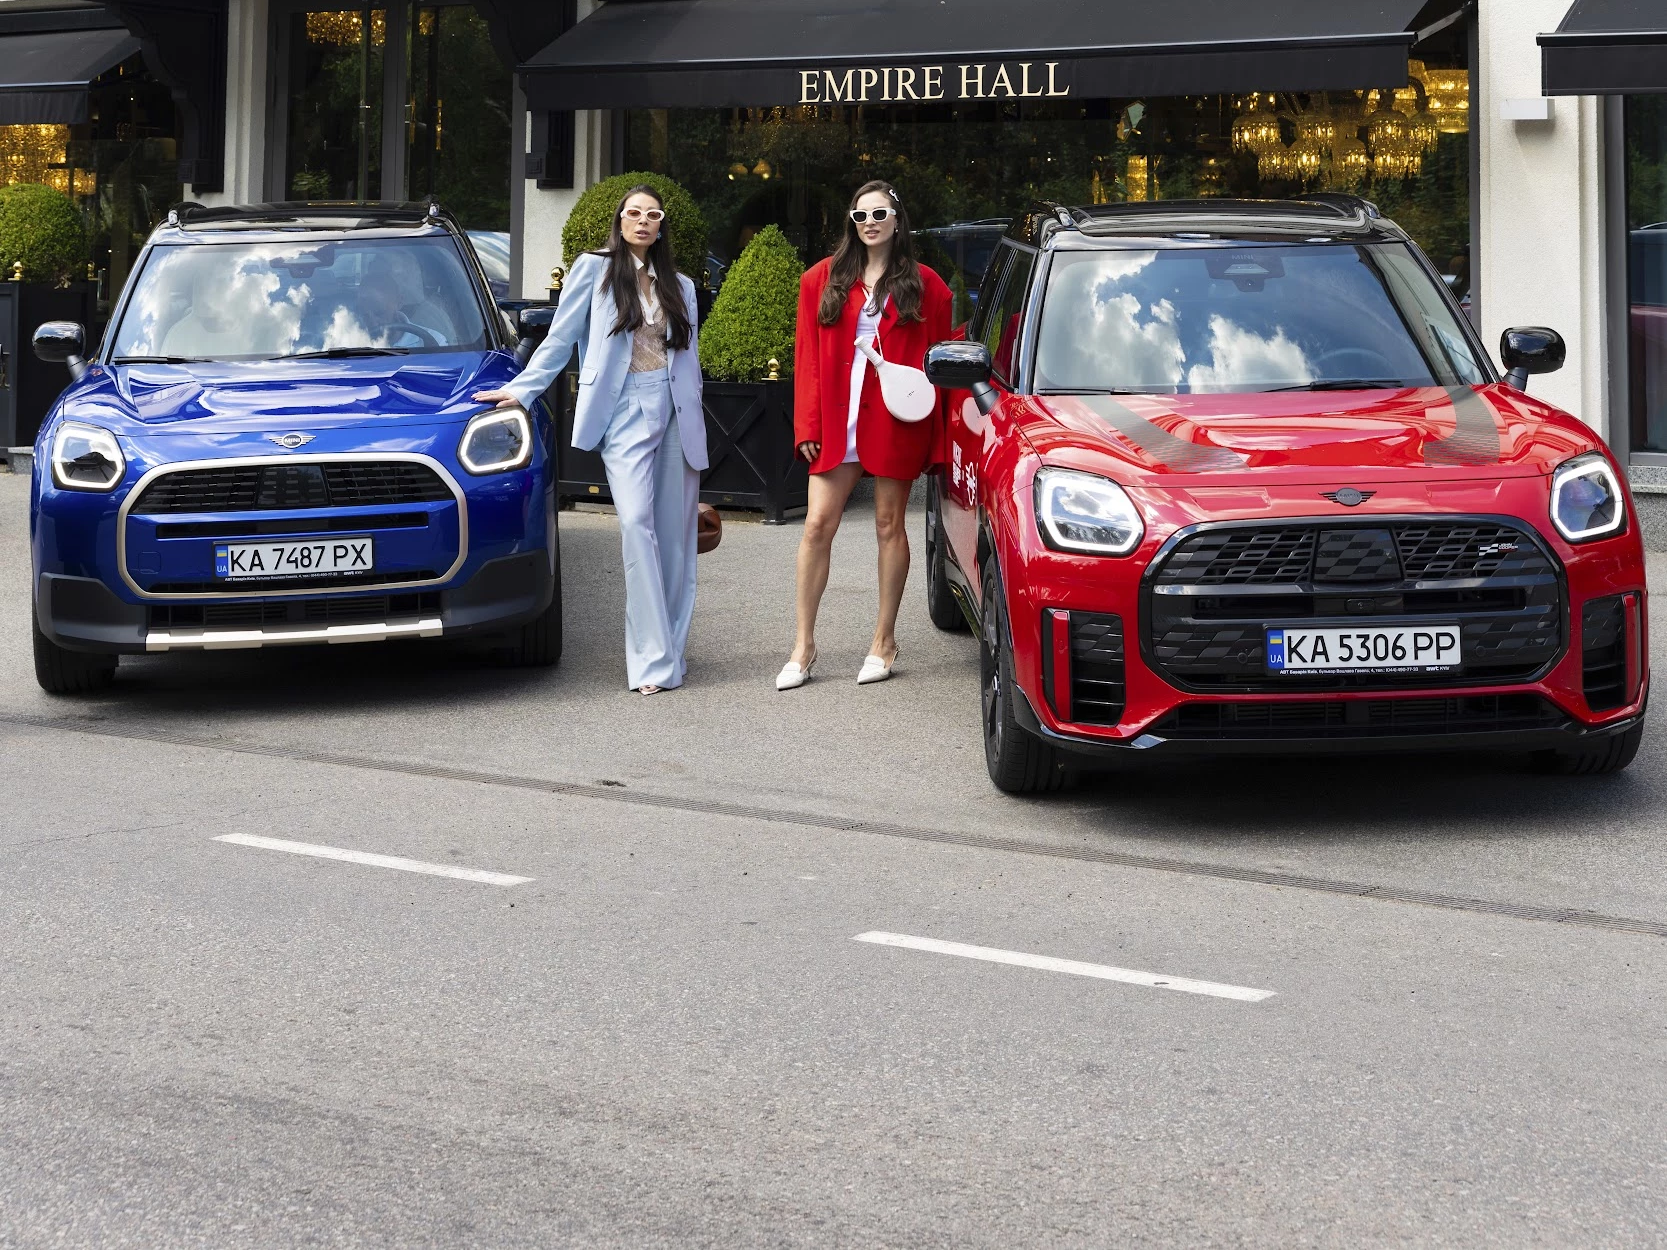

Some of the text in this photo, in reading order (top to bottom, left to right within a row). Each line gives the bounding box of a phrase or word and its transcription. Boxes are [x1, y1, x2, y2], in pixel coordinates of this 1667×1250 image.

[798, 62, 1071, 104] EMPIRE HALL
[230, 543, 367, 572] KA 7487 PX
[1270, 654, 1283, 664] UA
[1287, 632, 1456, 663] KA 5306 PP
